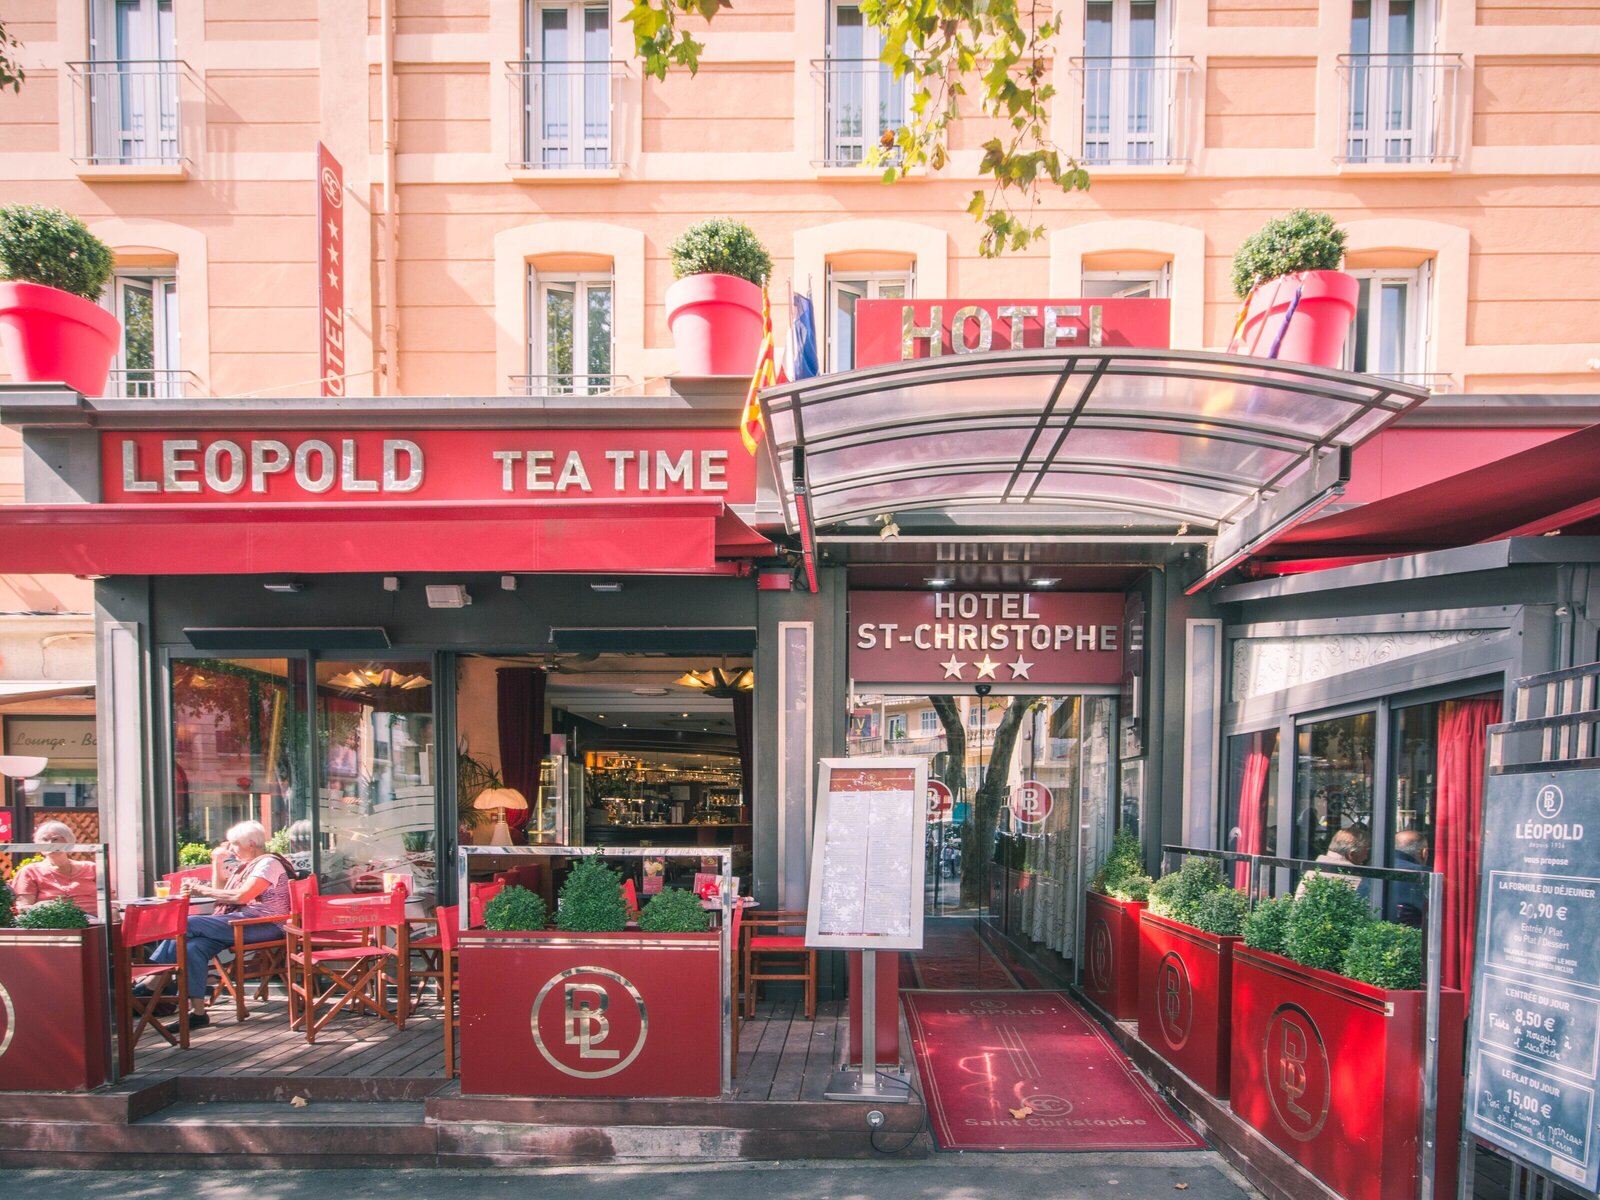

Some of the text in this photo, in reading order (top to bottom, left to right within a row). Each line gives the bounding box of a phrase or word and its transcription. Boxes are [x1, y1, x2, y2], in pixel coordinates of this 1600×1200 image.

[323, 306, 344, 397] OTEL
[121, 439, 425, 495] LEOPOLD
[493, 449, 729, 493] TEA TIME
[934, 592, 1040, 620] HOTEL
[856, 622, 1118, 651] ST-CHRISTOPHE
[13, 732, 66, 750] Lounge
[1515, 819, 1584, 841] LÉOPOLD
[1523, 856, 1569, 867] vous propose
[1499, 881, 1596, 899] LA FORMULE DU DÉJEUNER
[1556, 906, 1568, 921] €
[1521, 923, 1542, 933] Entrée
[1549, 926, 1563, 937] Plat
[1523, 934, 1537, 944] Plat
[1542, 938, 1569, 950] Dessert
[1505, 987, 1570, 1011] L'ENTRÉE DU JOUR
[1515, 1008, 1556, 1032] 8,50 €
[1502, 1068, 1561, 1098] LE PLAT DU JOUR
[1506, 1088, 1552, 1119] 15,00 €
[964, 1118, 1019, 1127] Saint
[1027, 1117, 1148, 1129] Christophe
